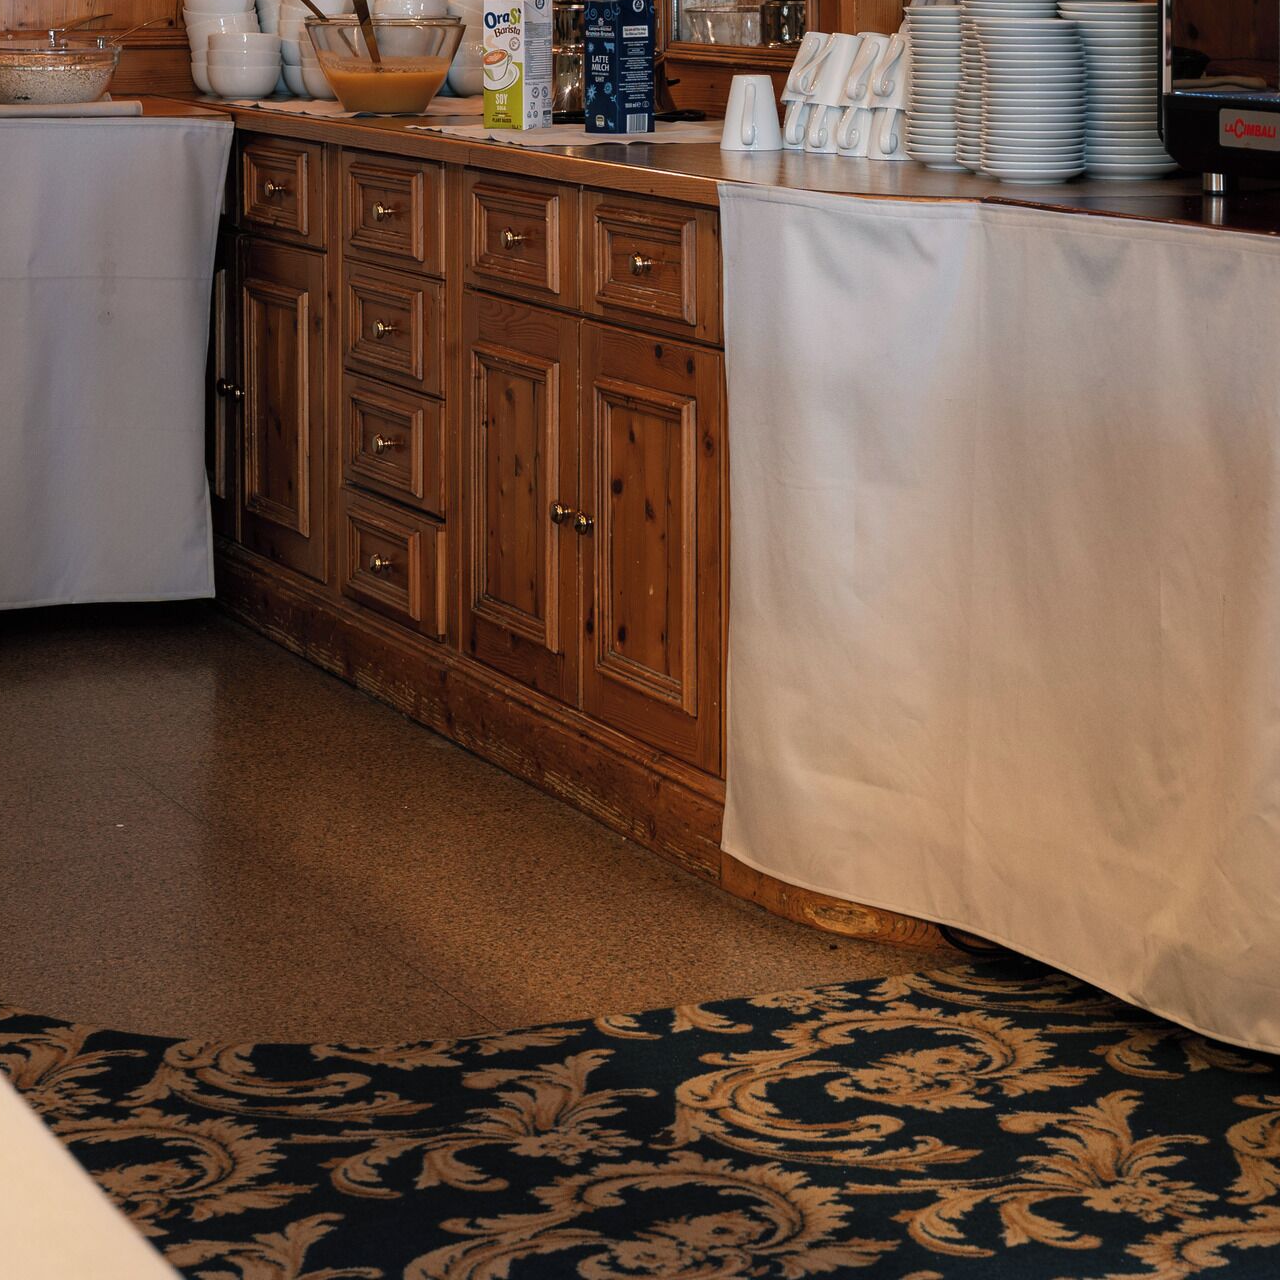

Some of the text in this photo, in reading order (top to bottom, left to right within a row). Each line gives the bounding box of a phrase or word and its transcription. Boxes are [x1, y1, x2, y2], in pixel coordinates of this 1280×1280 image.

[494, 25, 521, 37] Barista
[591, 55, 609, 63] LATTE
[591, 63, 610, 71] MILCH
[495, 93, 508, 104] SOY
